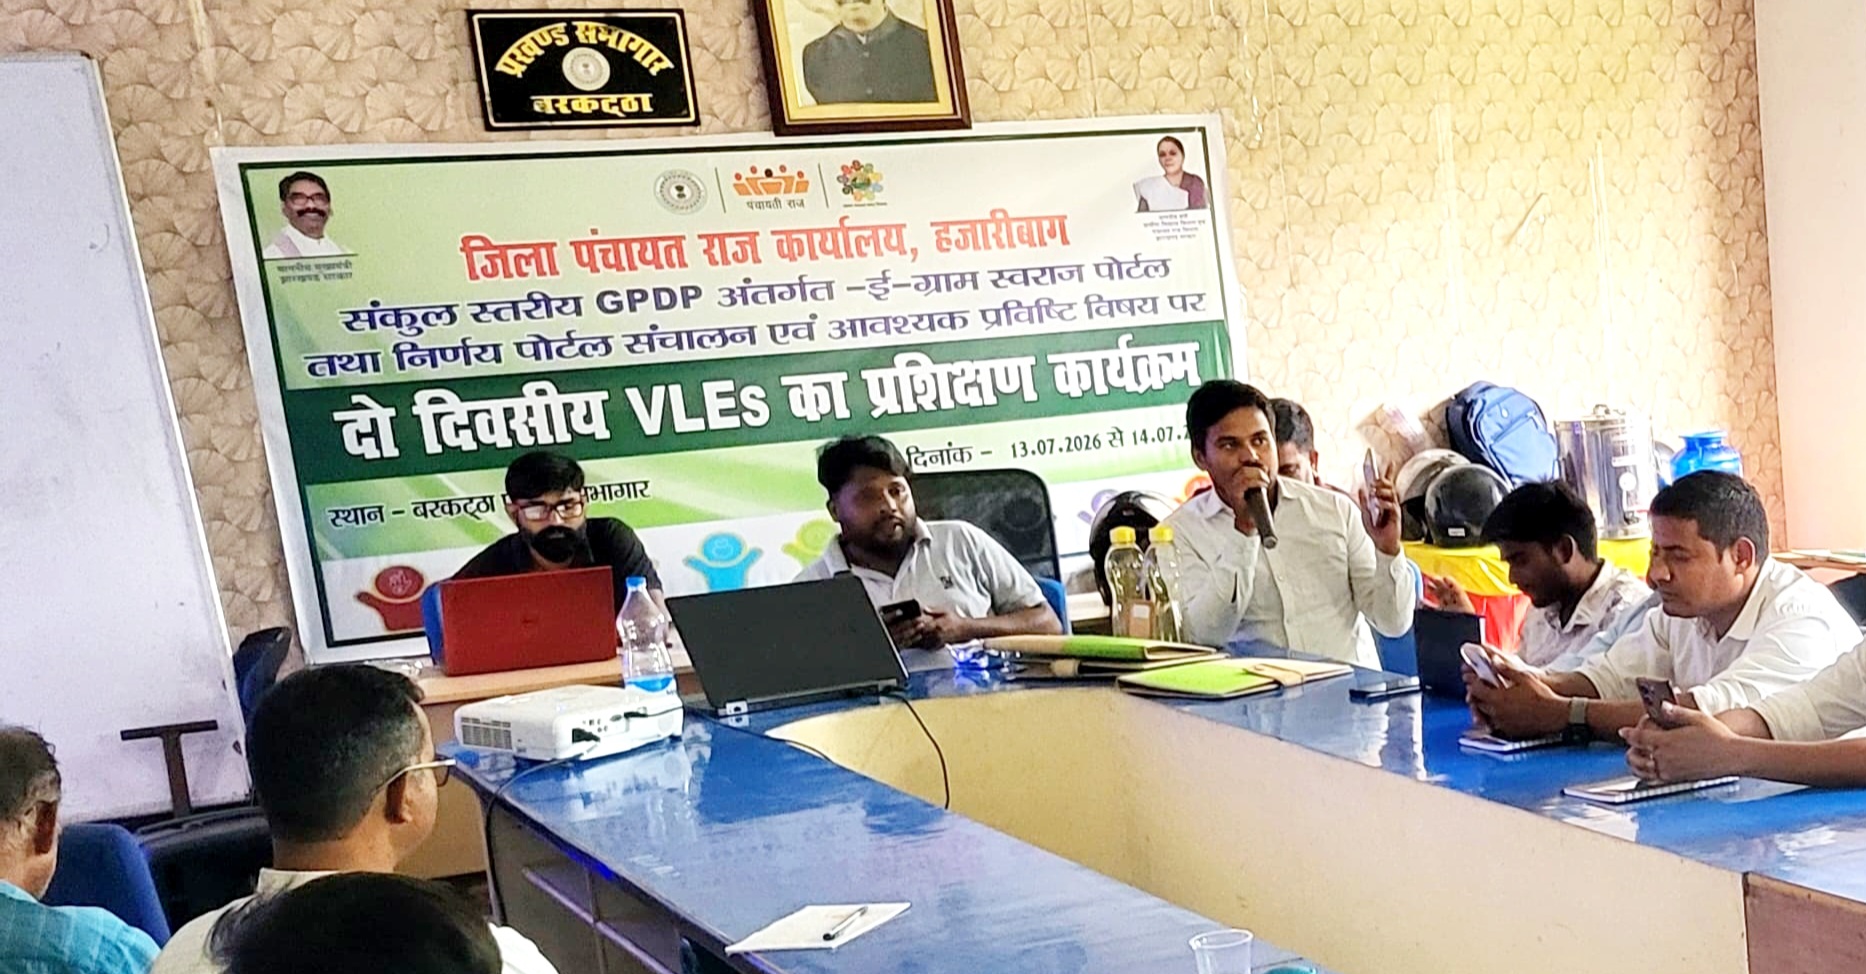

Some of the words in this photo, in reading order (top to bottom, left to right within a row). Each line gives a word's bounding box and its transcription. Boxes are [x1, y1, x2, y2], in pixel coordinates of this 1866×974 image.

[495, 22, 569, 78] प्रखण्ड
[572, 21, 675, 76] सभागार
[459, 234, 559, 281] जिला
[569, 228, 687, 274] पंचायत
[701, 229, 762, 266] राज
[775, 215, 920, 264] कार्यालय,
[934, 208, 1071, 253] हजारीबाग
[339, 300, 460, 336] संकुल
[468, 290, 584, 321] स्तरीय
[596, 285, 703, 317] GPDP
[717, 274, 836, 307] अंतर्गत
[988, 261, 1086, 290] स्वराज
[1093, 254, 1172, 285] पोर्टल
[304, 352, 381, 379] तथा
[392, 336, 502, 373] निर्णय
[515, 330, 614, 362] पोर्टल
[623, 322, 757, 355] संचालन
[767, 312, 817, 345] एवं
[827, 308, 971, 341] आवश्यक
[978, 296, 1078, 329] प्रविष्टि
[1084, 292, 1160, 322] विषय
[1168, 291, 1208, 314] पर
[333, 394, 399, 460] दो
[412, 387, 612, 456] दिवसीय
[624, 379, 771, 437] VLEs
[780, 368, 852, 427] का
[860, 350, 1039, 420] प्रशिक्षण
[1047, 334, 1203, 398] कार्यक्रम
[906, 442, 973, 468] दिनांक
[1011, 434, 1101, 459] 13.07.2026
[1106, 426, 1124, 448] से
[328, 504, 385, 527] स्थान
[411, 495, 496, 522] बरकट्ठा
